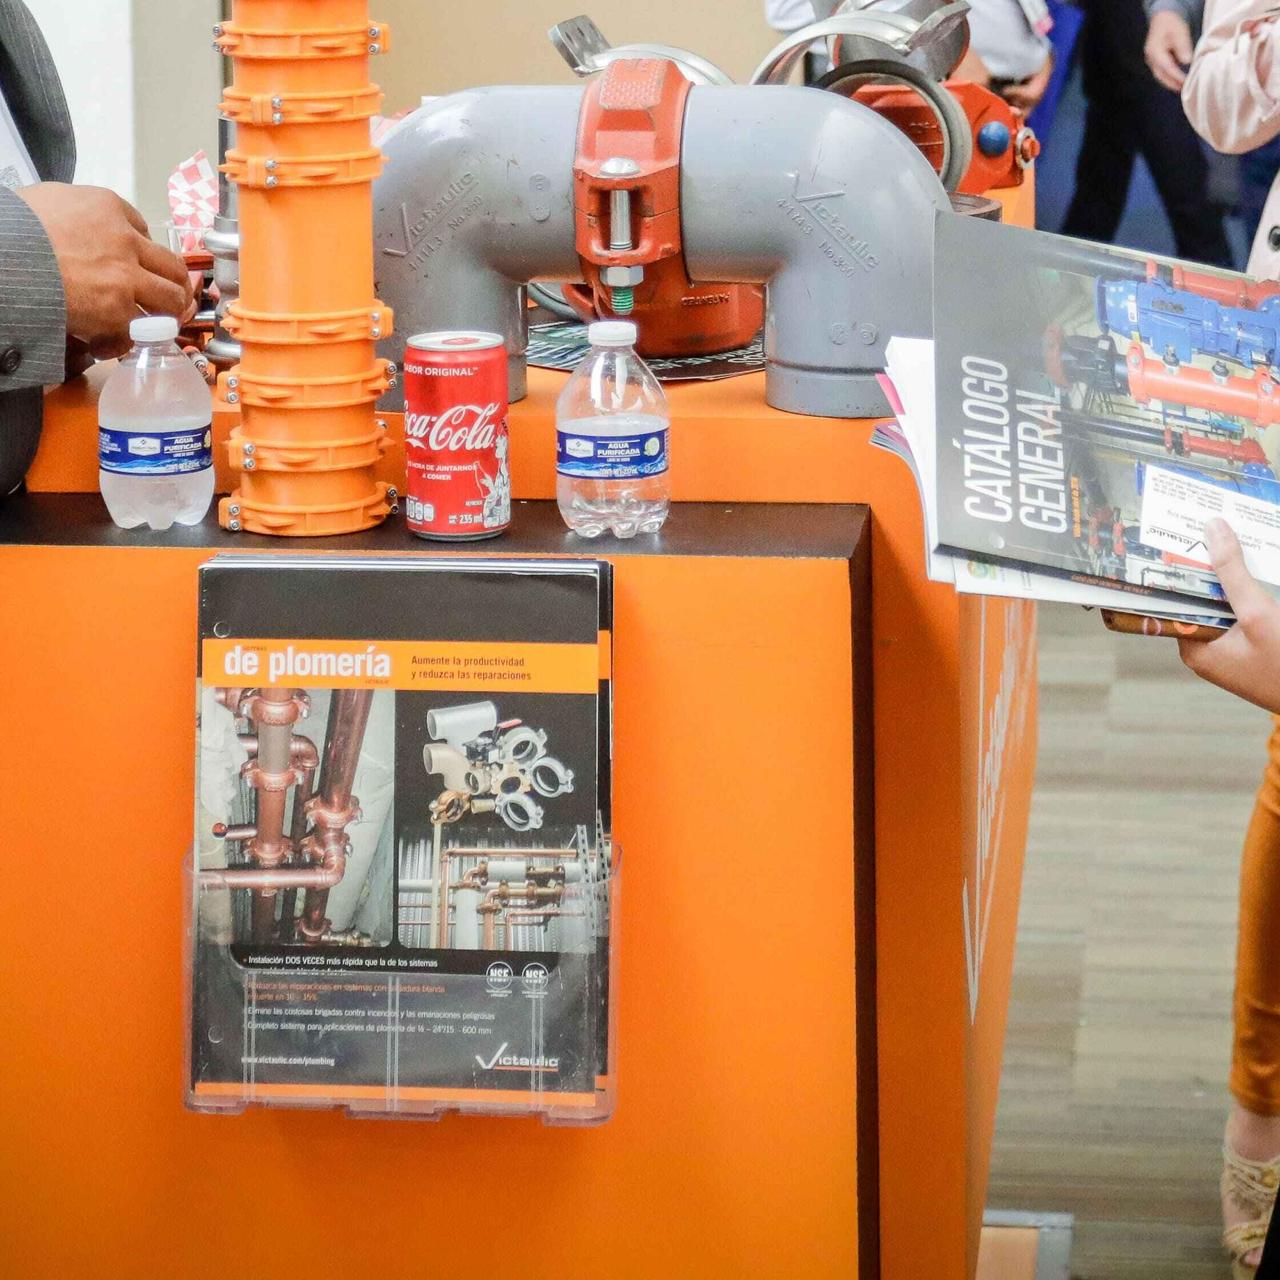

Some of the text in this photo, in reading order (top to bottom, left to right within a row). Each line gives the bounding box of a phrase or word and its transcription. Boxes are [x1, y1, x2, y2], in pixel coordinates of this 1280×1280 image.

[383, 171, 476, 258] Victaulic
[174, 437, 194, 445] AGUA
[952, 354, 1013, 524] CATÁLOGO
[163, 442, 202, 452] PURIFICADA
[597, 449, 641, 457] PURIFICADA
[1018, 387, 1067, 535] GENERAL
[224, 645, 391, 683] de plomería
[411, 655, 525, 668] Aumente la productividad
[411, 669, 532, 681] y reduzca las reparaciones
[249, 955, 438, 968] Instalación DOS VECES más rápida que la de los sistemas
[285, 1008, 313, 1016] costosas
[315, 1008, 343, 1017] brigadas
[345, 1009, 366, 1017] contra
[406, 1010, 416, 1018] las
[417, 1011, 461, 1019] emanaciones
[462, 1011, 496, 1021] peligrosas
[475, 1041, 560, 1070] Victaulic
